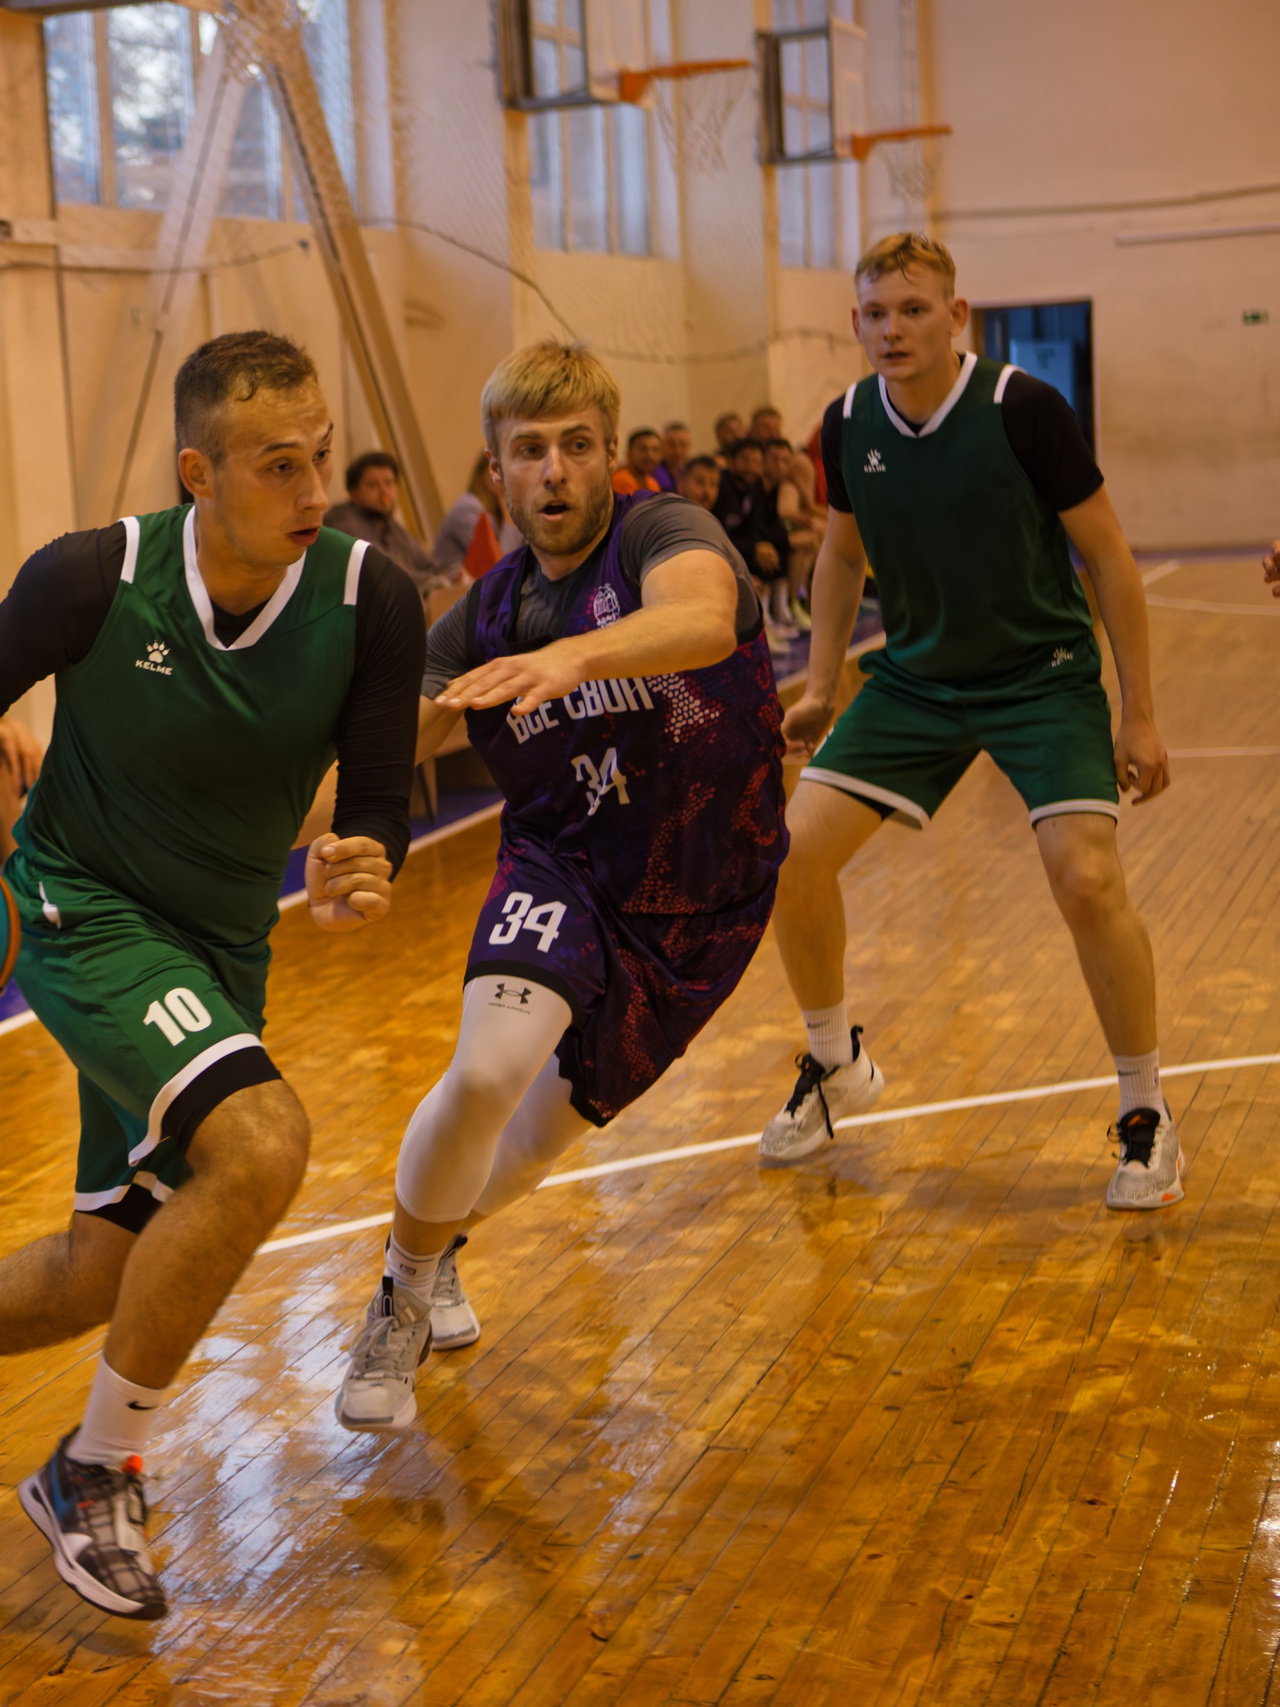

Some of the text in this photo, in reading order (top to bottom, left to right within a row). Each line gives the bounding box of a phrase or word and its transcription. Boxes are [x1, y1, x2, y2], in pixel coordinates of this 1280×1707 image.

[135, 659, 173, 675] KELME
[571, 747, 630, 816] 34
[488, 891, 567, 953] 34
[143, 987, 212, 1047] 10
